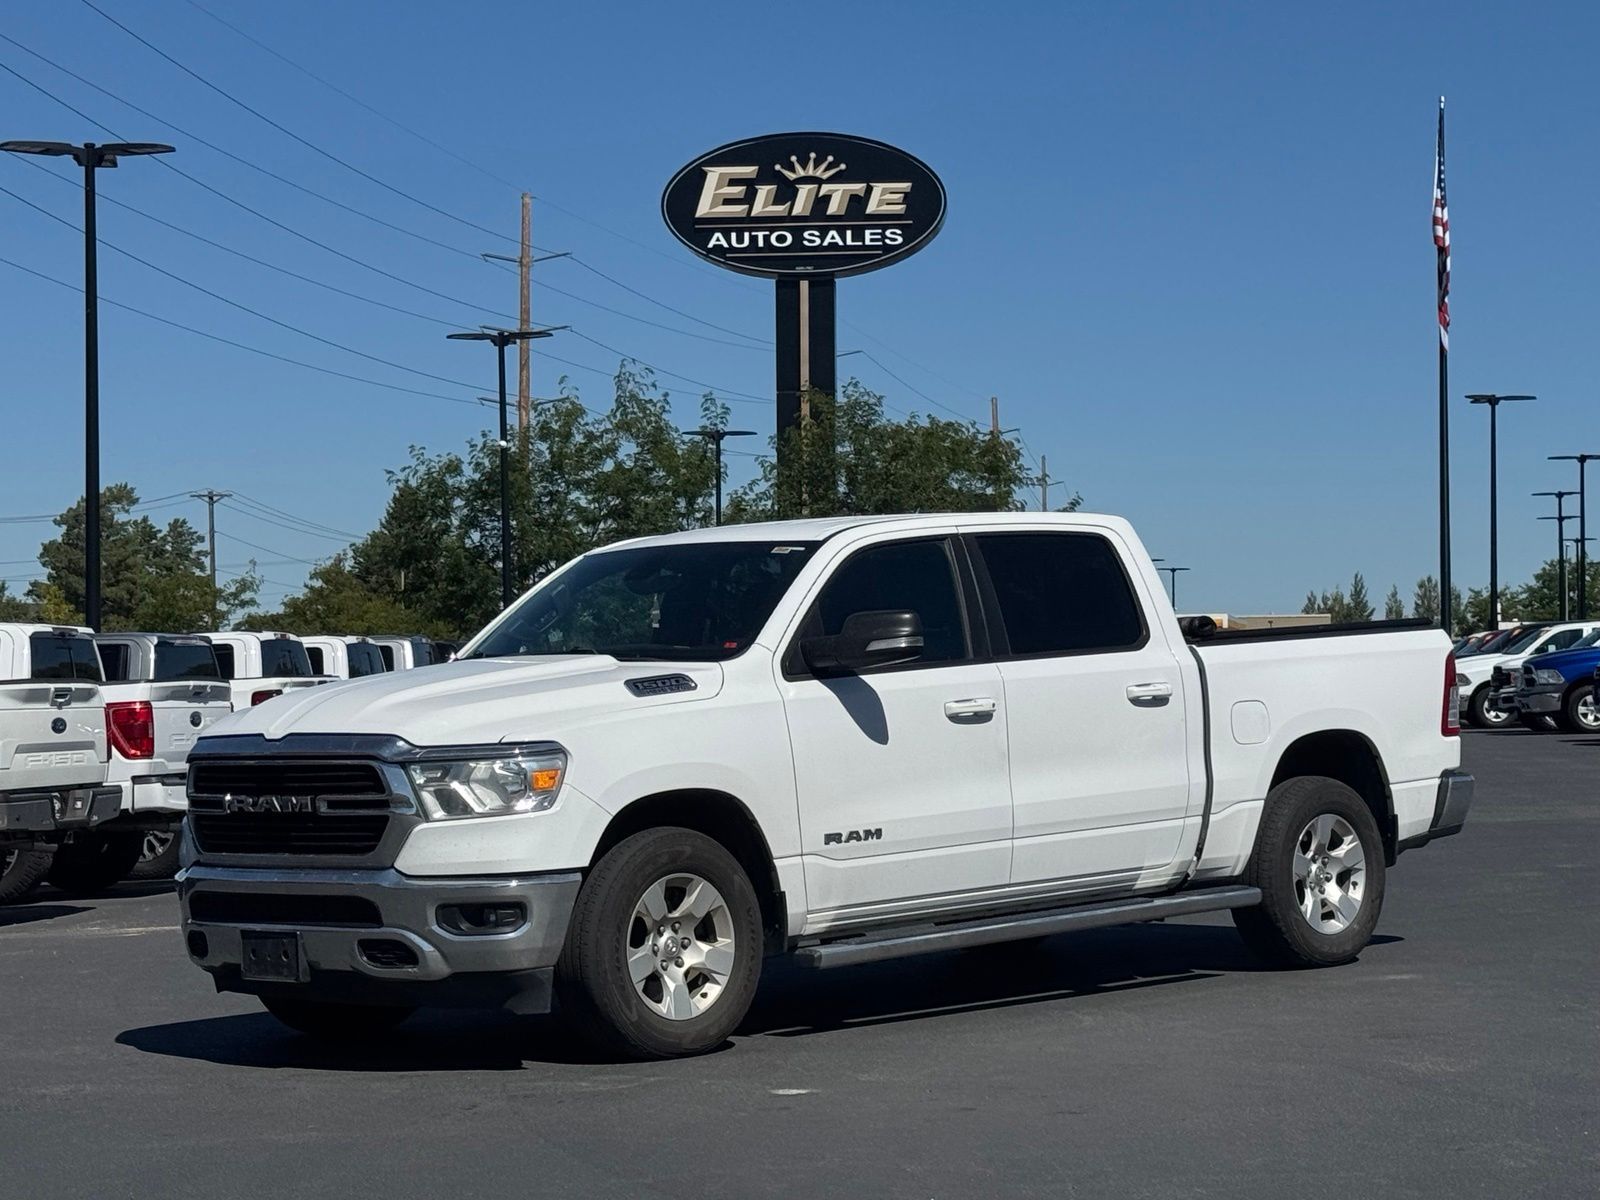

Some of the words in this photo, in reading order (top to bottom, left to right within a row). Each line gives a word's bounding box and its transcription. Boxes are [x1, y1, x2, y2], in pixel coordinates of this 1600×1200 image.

[694, 165, 913, 219] ELITE
[706, 230, 794, 249] AUTO
[802, 228, 904, 247] SALES
[25, 752, 87, 769] F-150
[229, 794, 314, 813] RAM
[823, 827, 883, 846] RAM
